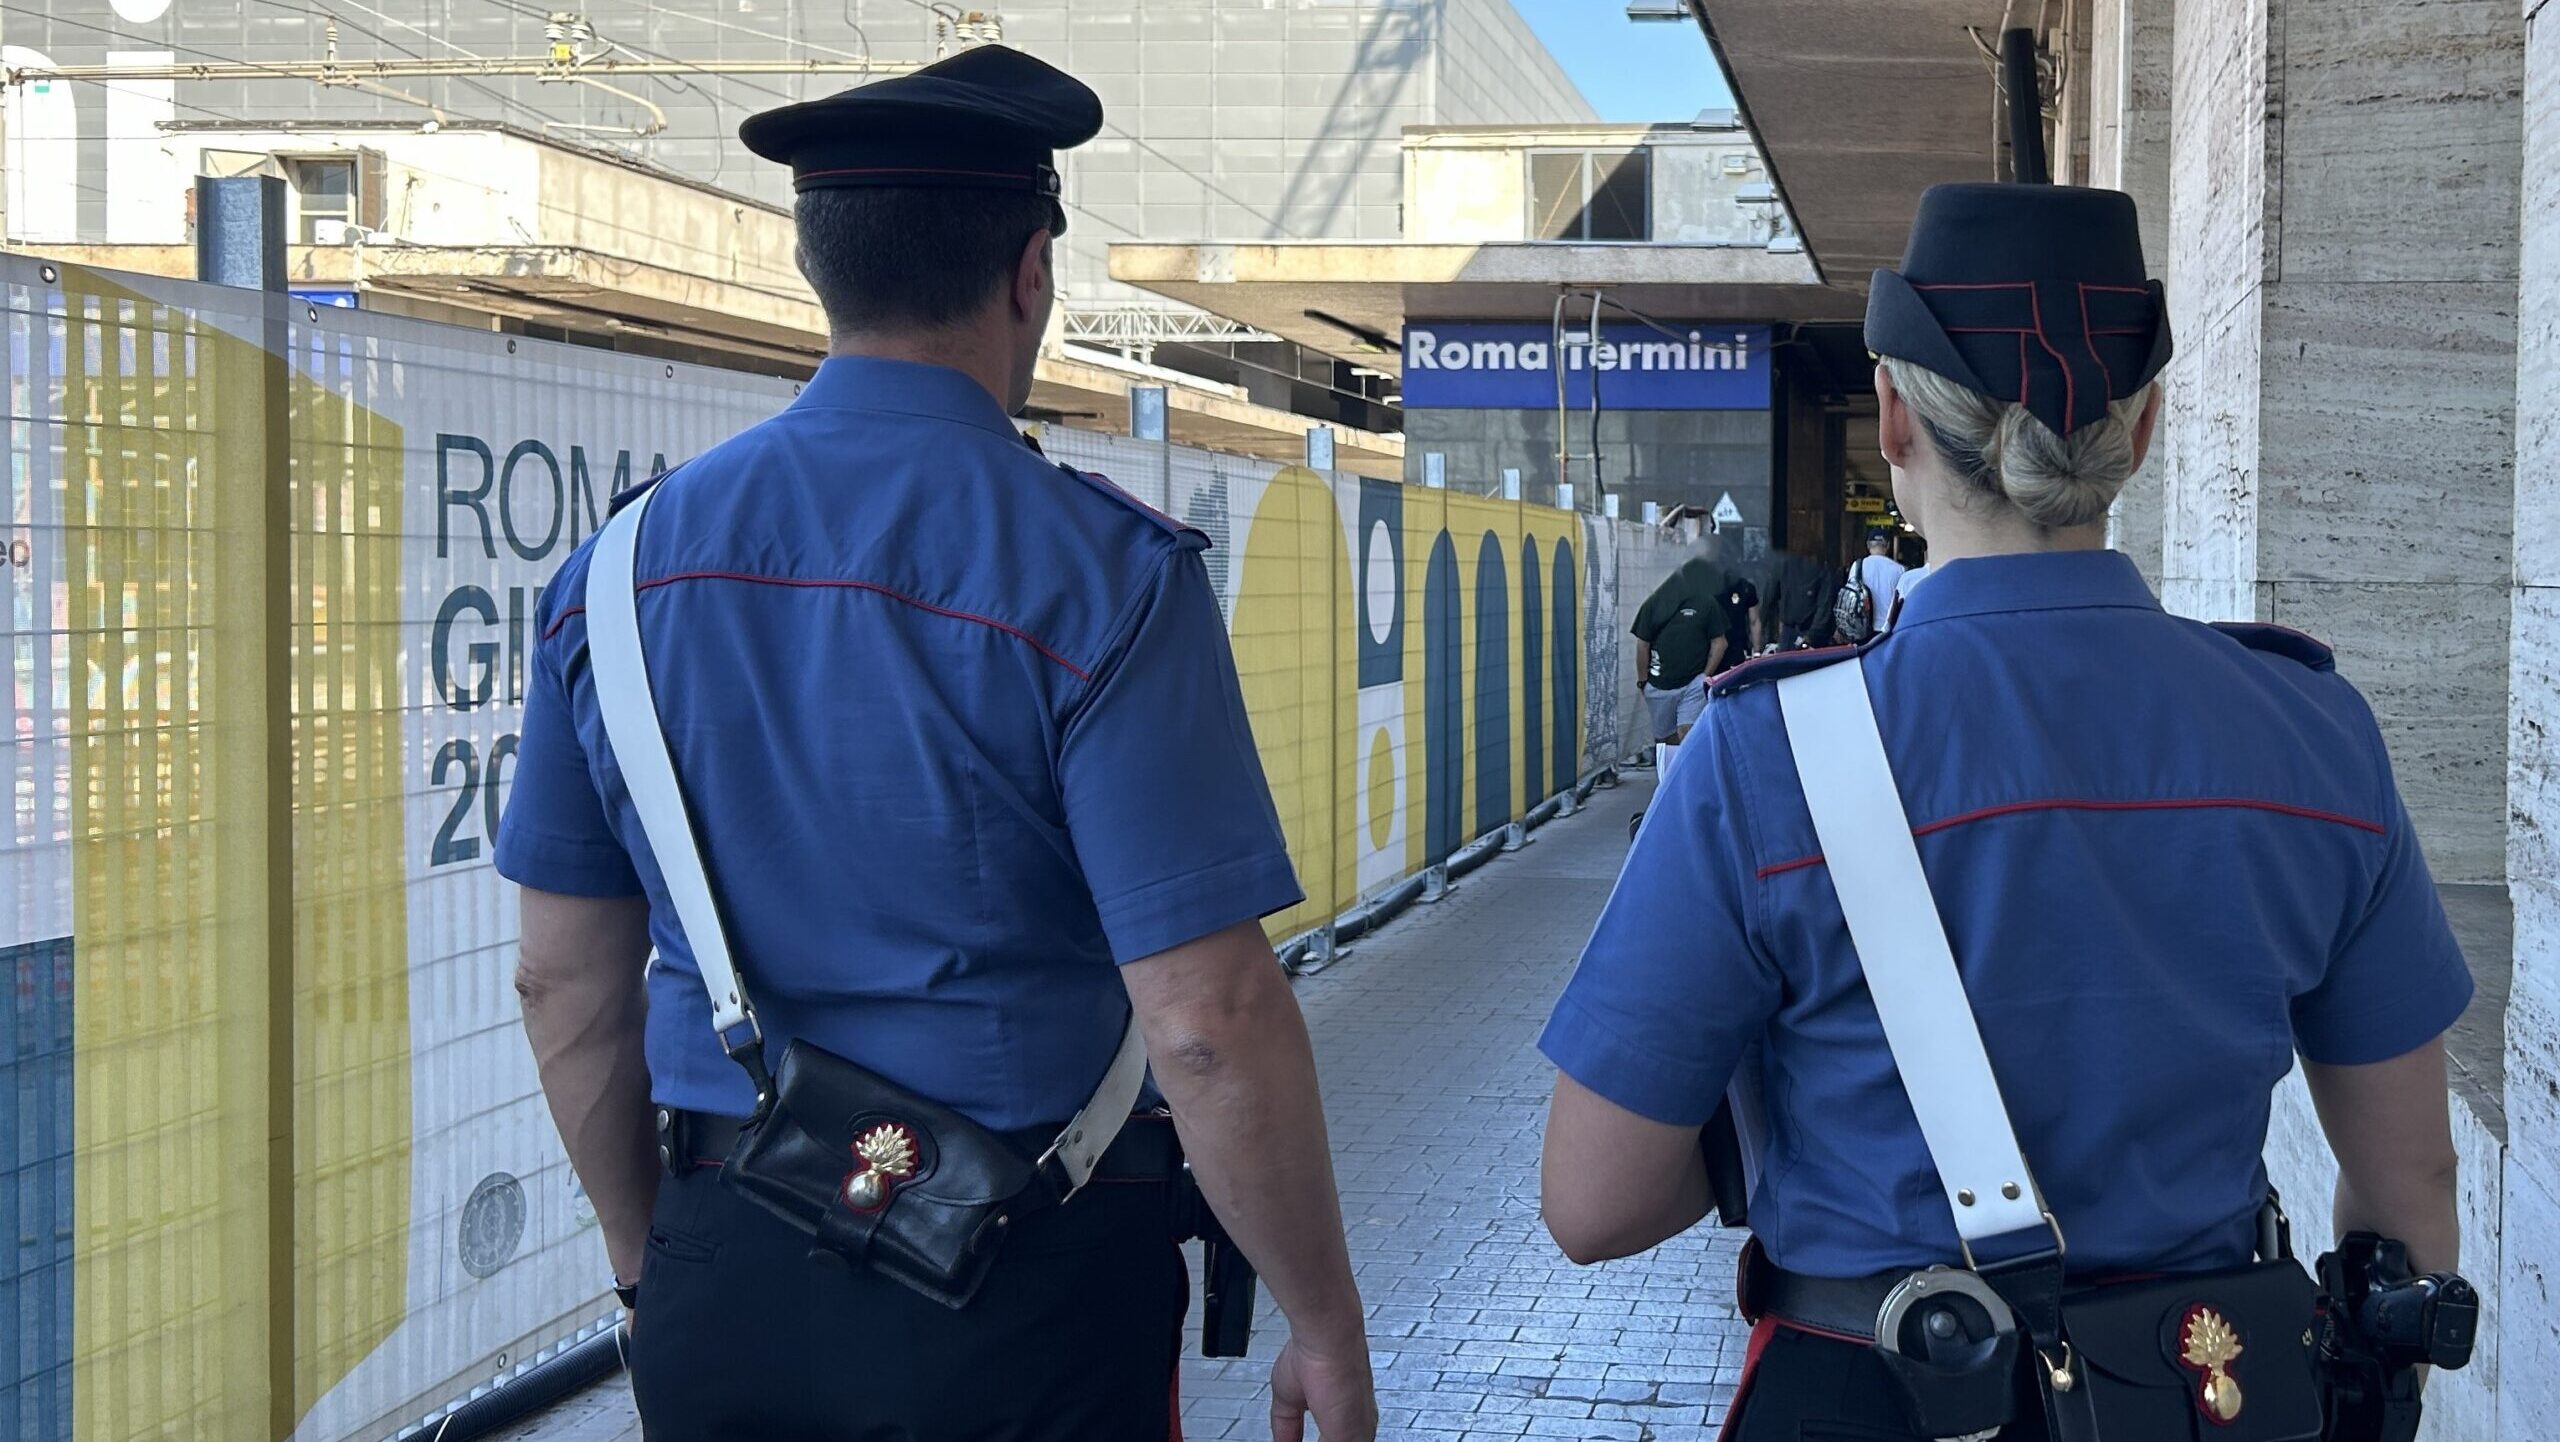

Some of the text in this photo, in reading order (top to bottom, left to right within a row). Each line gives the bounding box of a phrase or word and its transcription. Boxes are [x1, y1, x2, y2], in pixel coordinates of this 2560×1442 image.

[1408, 330, 1748, 371] Roma Termini
[435, 432, 668, 562] ROM
[431, 584, 546, 712] GI
